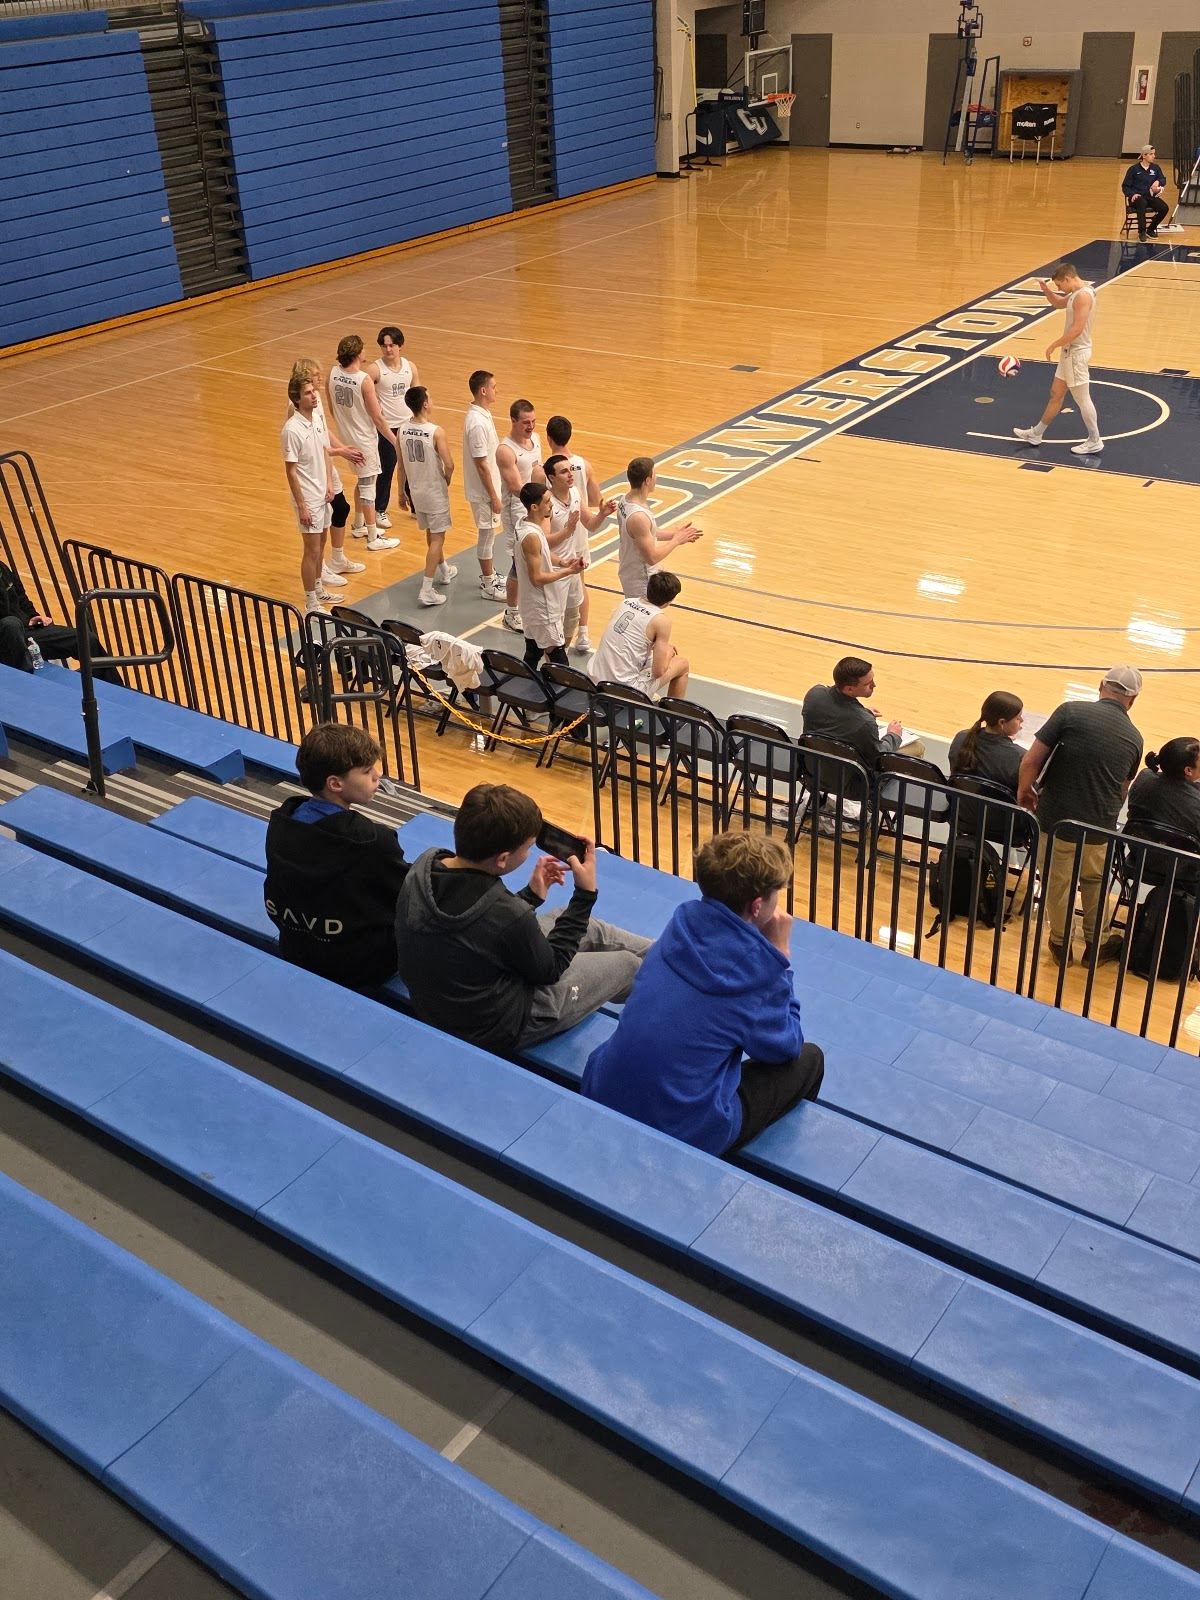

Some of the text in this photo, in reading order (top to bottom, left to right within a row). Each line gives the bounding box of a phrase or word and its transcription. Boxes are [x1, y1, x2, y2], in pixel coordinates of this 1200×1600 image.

[737, 108, 768, 136] CU
[333, 376, 357, 386] EAGLES
[335, 384, 354, 409] 20
[588, 277, 1096, 554] ORNERSTON
[402, 430, 430, 438] EAGLES
[406, 438, 425, 462] 10
[613, 610, 636, 634] 6
